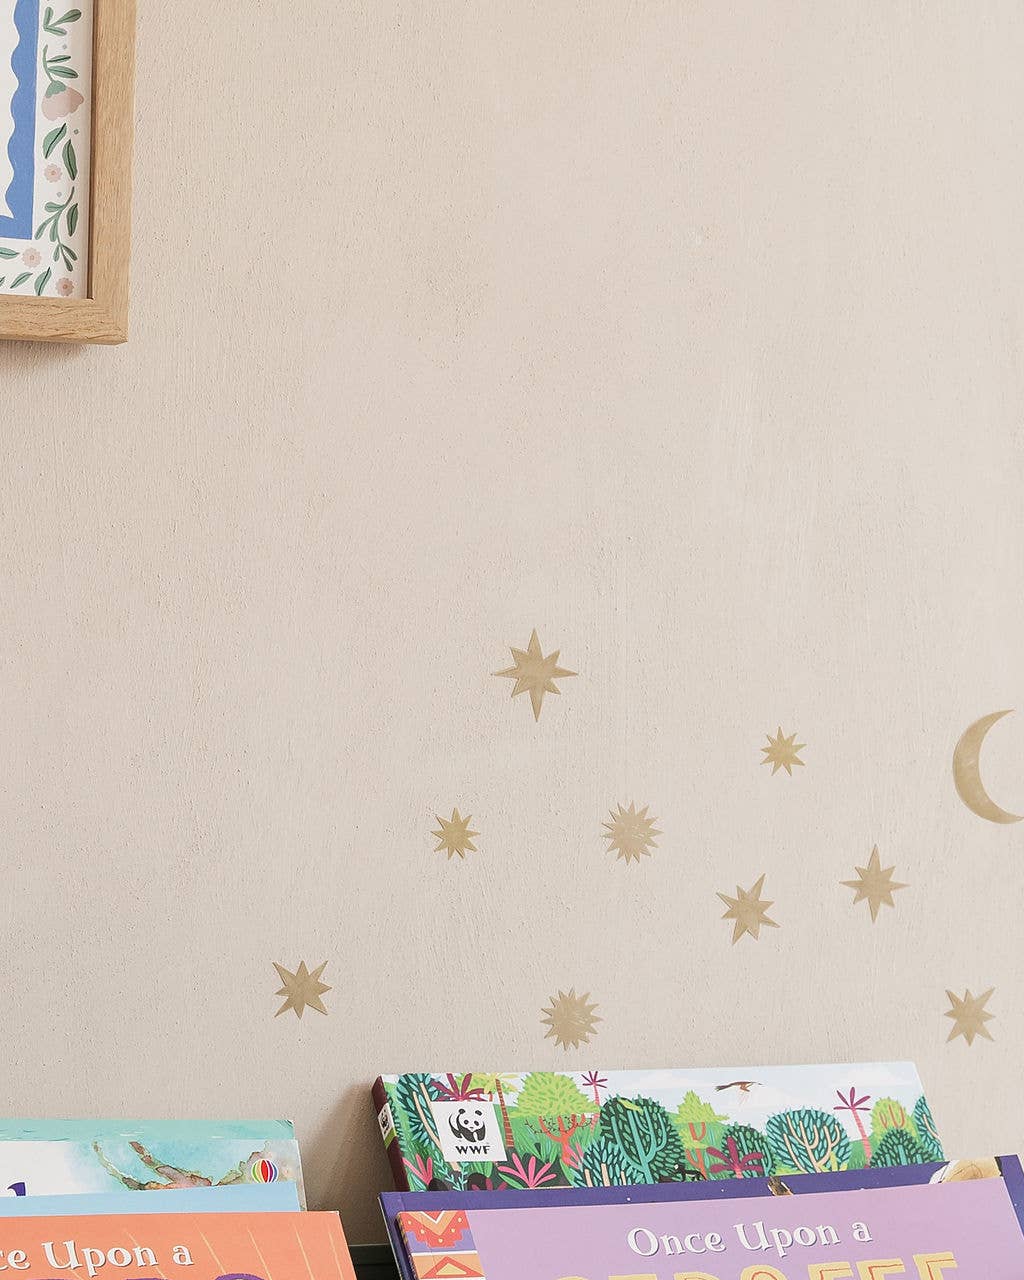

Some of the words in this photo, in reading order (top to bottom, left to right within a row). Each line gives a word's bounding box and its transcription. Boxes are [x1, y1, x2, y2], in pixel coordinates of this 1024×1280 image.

[455, 1145, 491, 1155] WWF
[627, 1227, 727, 1257] Once
[733, 1219, 841, 1258] Upon
[851, 1221, 874, 1243] a
[41, 1239, 159, 1278] Upon
[172, 1244, 195, 1267] a
